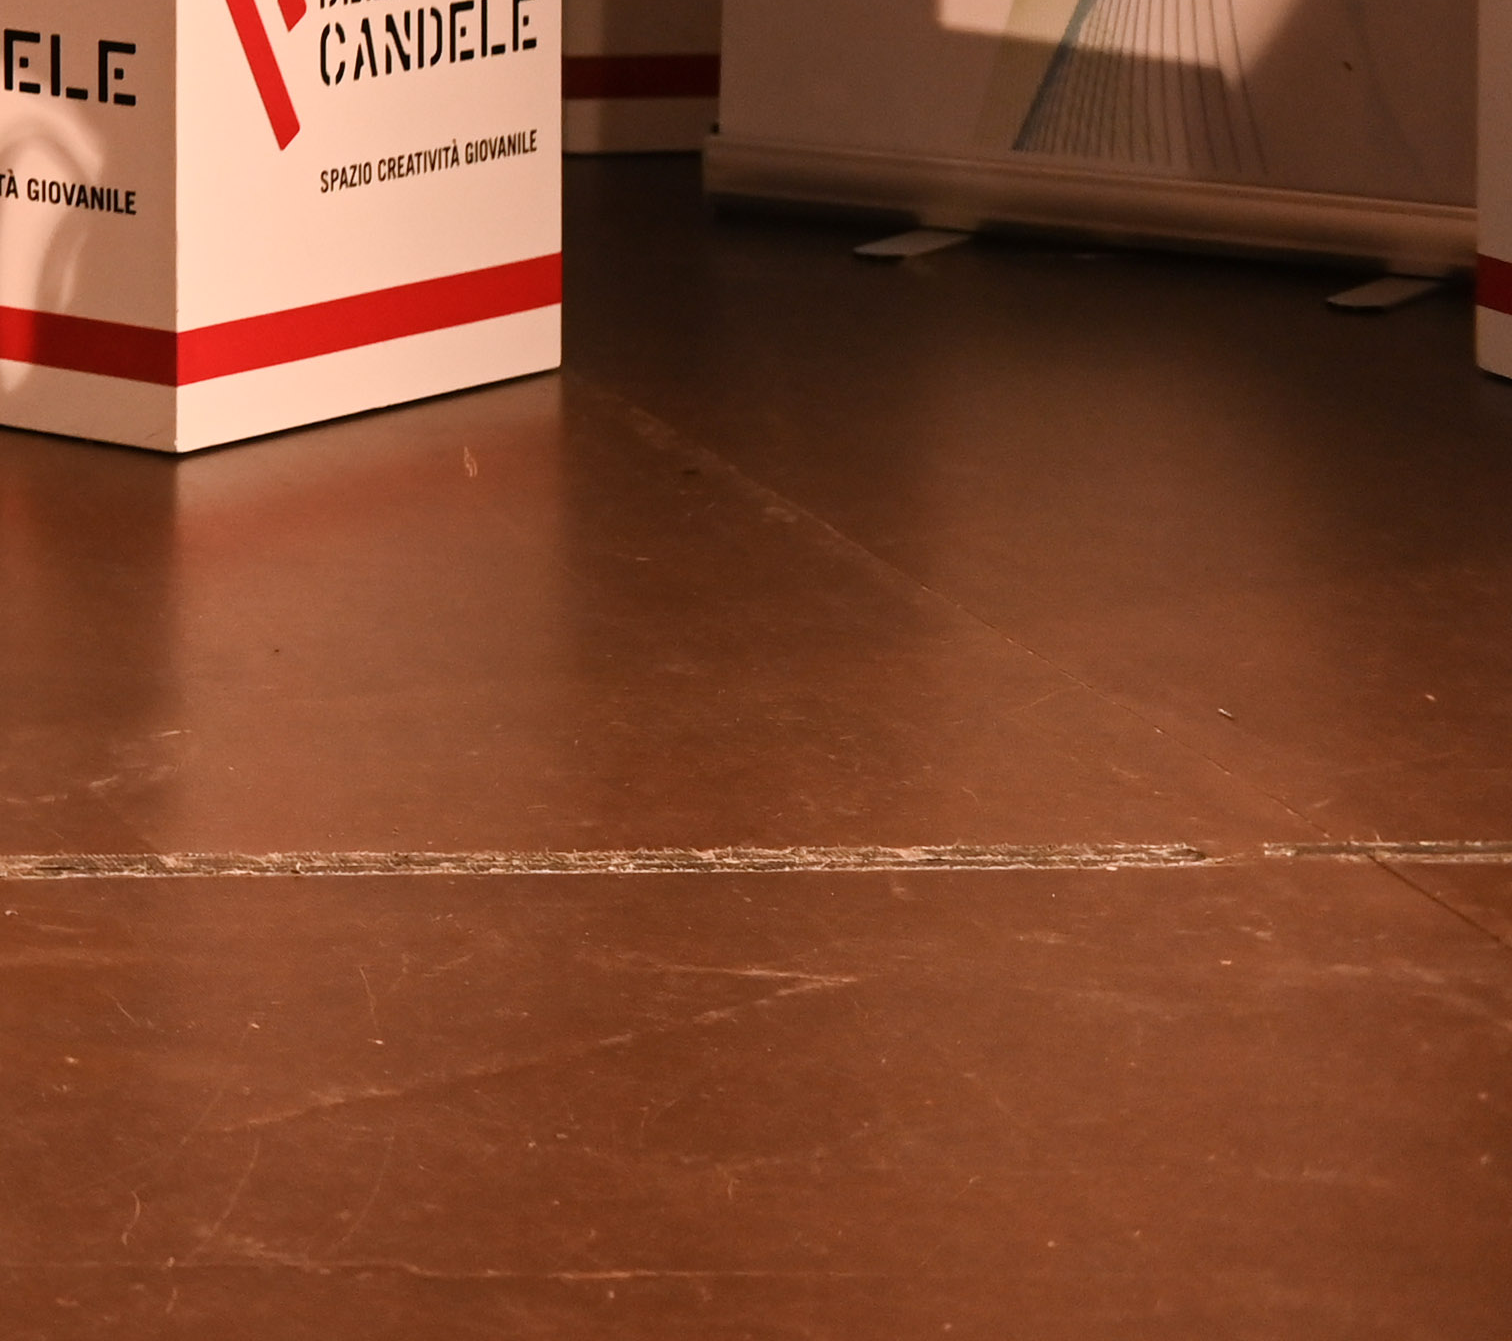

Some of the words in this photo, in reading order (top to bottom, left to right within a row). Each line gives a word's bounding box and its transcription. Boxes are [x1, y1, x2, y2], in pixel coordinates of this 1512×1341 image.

[321, 160, 373, 194] SPAZIO
[377, 138, 461, 186] CREATIVITÀ
[464, 129, 538, 167] GIOVANILE
[26, 176, 136, 216] GIOVANILE
